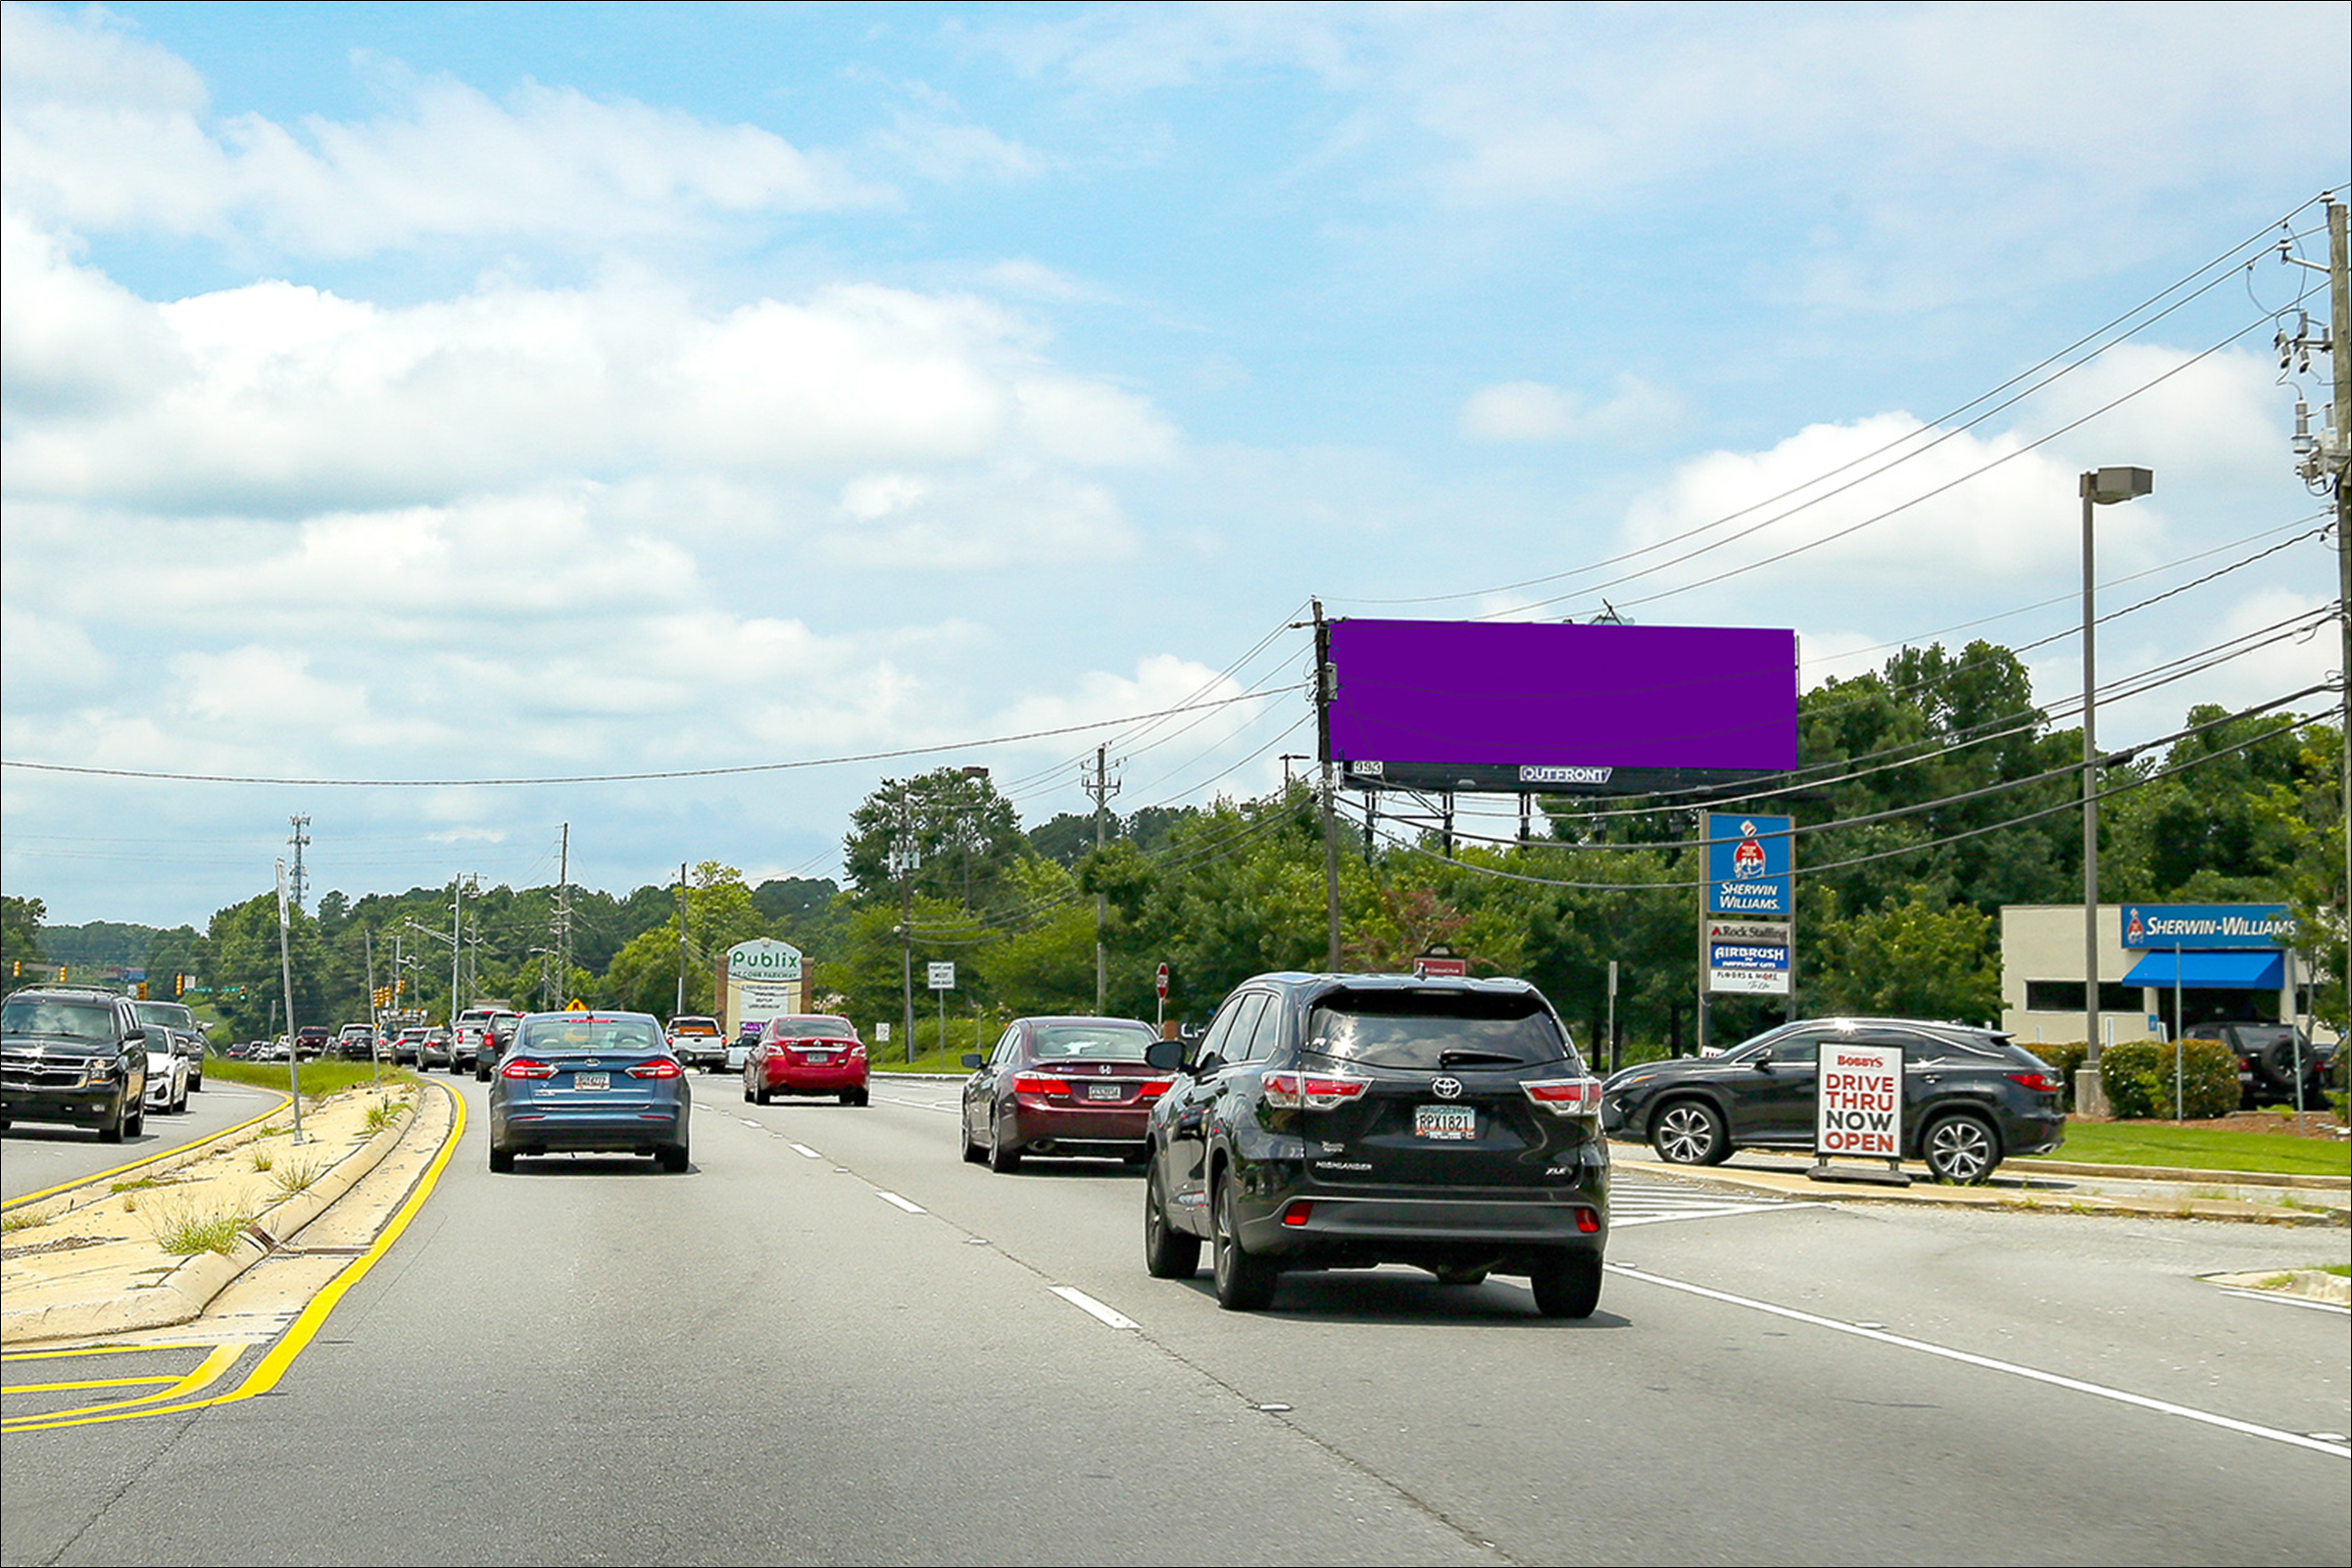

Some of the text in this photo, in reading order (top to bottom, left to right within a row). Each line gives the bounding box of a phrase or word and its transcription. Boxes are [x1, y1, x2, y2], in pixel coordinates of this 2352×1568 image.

[1524, 767, 1608, 782] OUTFRONT
[1720, 882, 1778, 896] SHERWIN
[2146, 916, 2296, 936] SHERWIN-WILLIAMS
[732, 951, 798, 968] Publix
[1714, 947, 1785, 961] AIRBRUSH
[1826, 1073, 1894, 1093] DRIVE
[1826, 1091, 1893, 1111] THRU
[1419, 1114, 1469, 1132] RPX1821
[1826, 1110, 1893, 1132] NOW
[1825, 1132, 1893, 1152] OPEN
